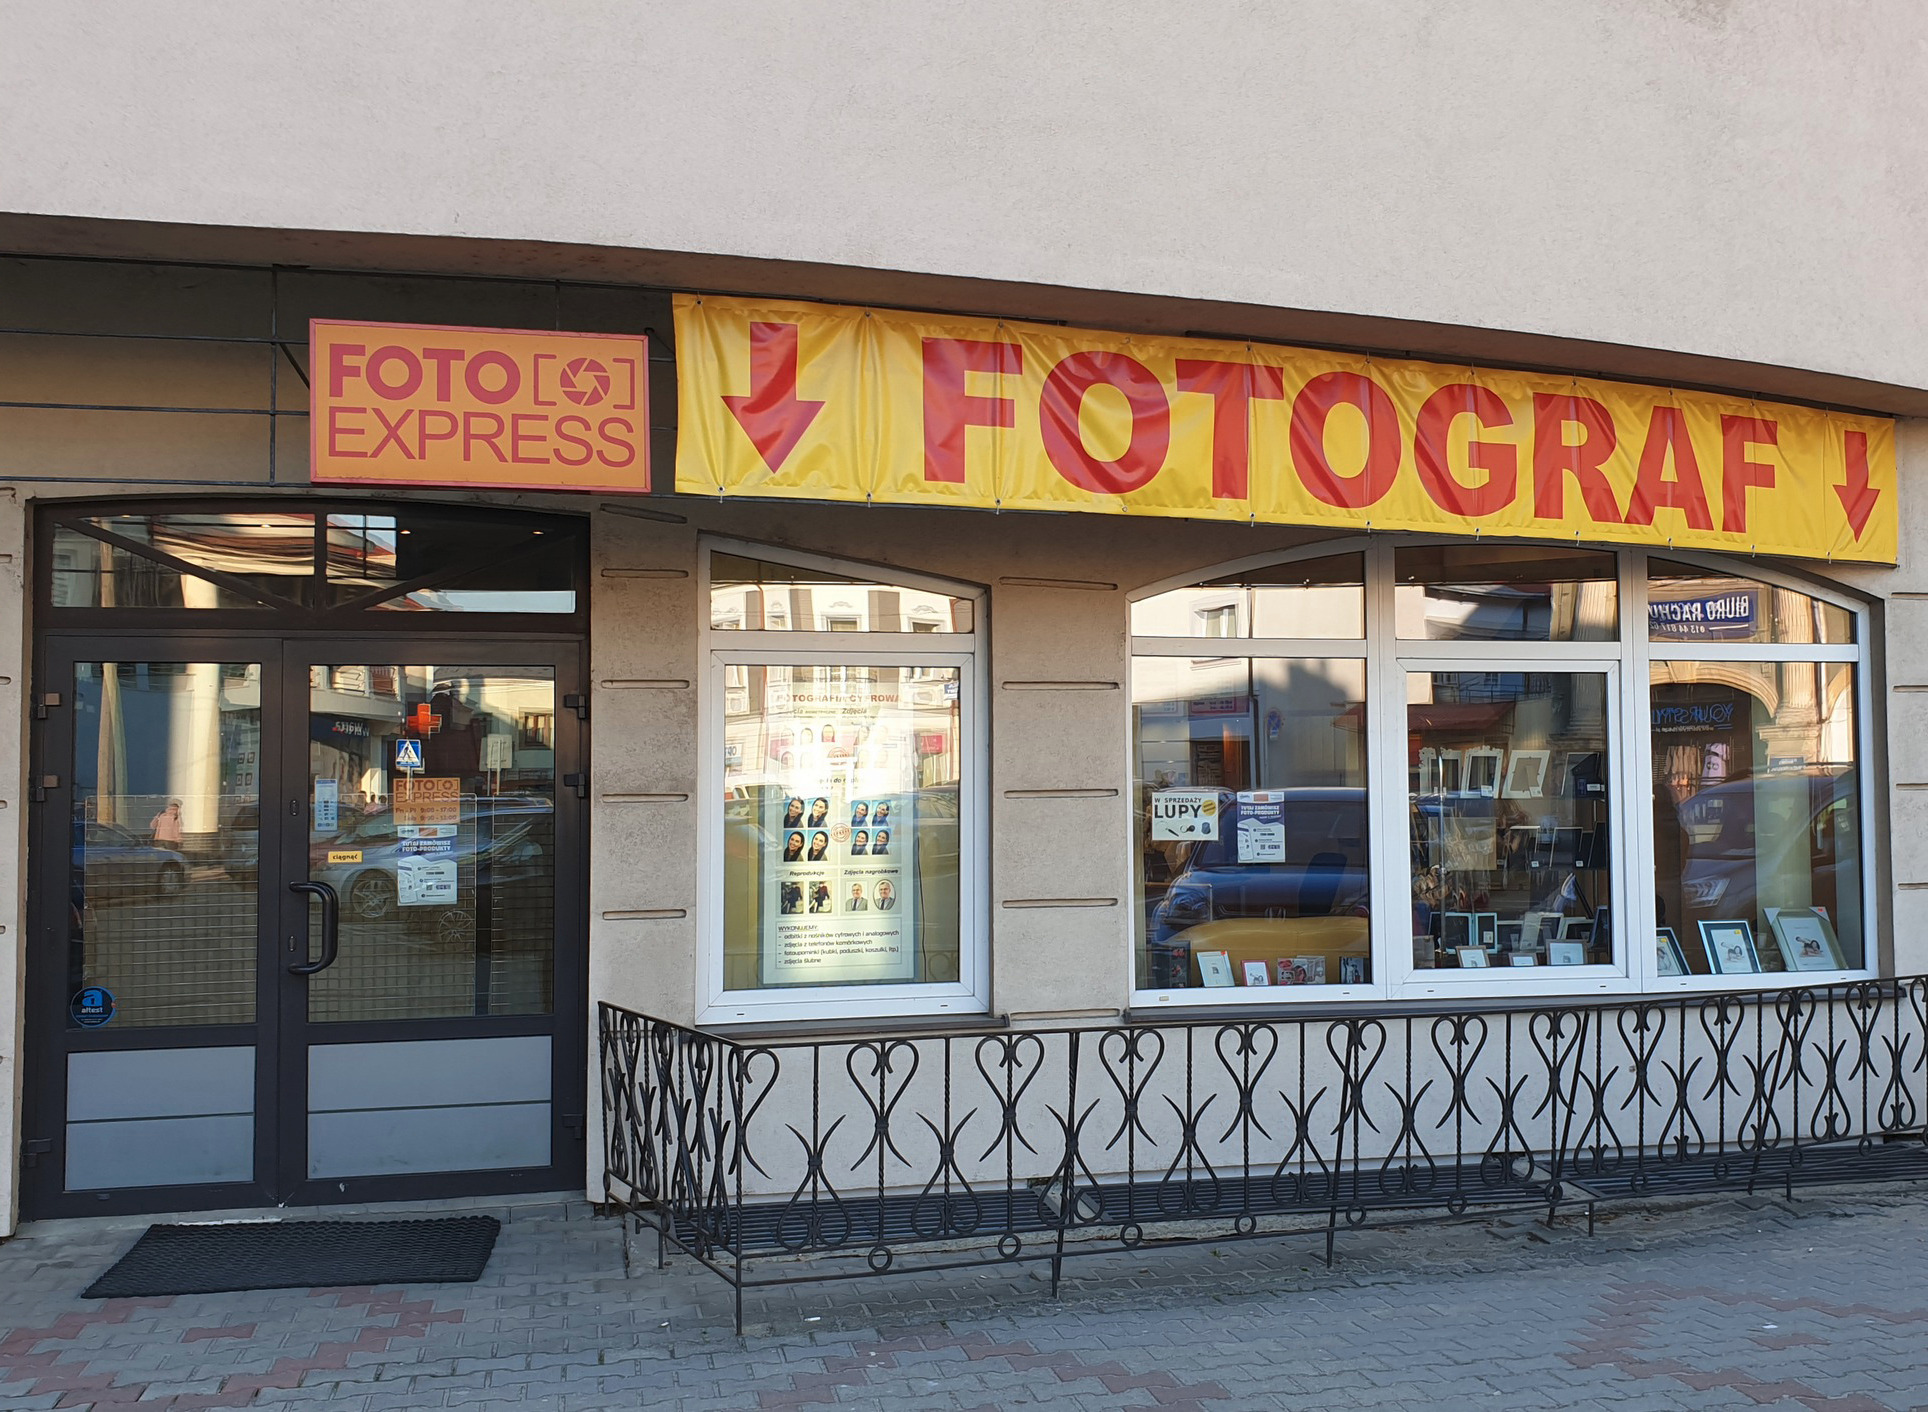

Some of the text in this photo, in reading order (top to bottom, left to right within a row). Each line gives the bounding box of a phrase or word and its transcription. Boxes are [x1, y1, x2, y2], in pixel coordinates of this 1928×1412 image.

[329, 342, 521, 405] FOTO
[328, 405, 636, 468] EXPRESS
[922, 336, 1778, 534] FOTOGRAF
[395, 780, 435, 791] FOTO
[395, 790, 459, 803] EXPRESS
[1154, 804, 1202, 819] LUPY
